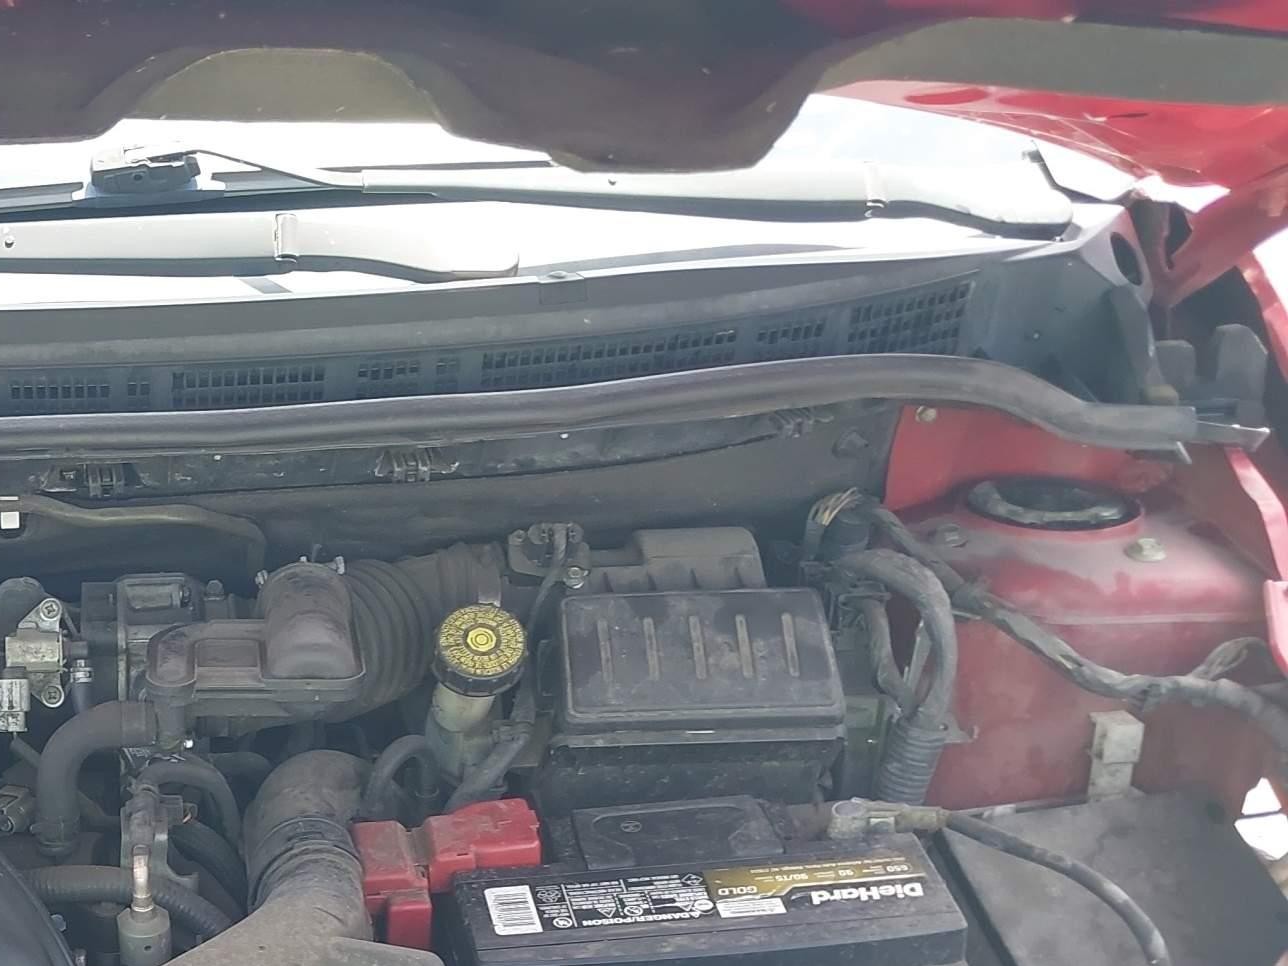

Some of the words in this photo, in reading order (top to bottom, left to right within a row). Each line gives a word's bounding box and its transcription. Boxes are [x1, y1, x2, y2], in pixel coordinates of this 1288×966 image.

[717, 885, 758, 896] GOLD
[810, 882, 924, 905] DieHard
[582, 912, 691, 927] DANGER/POISON
